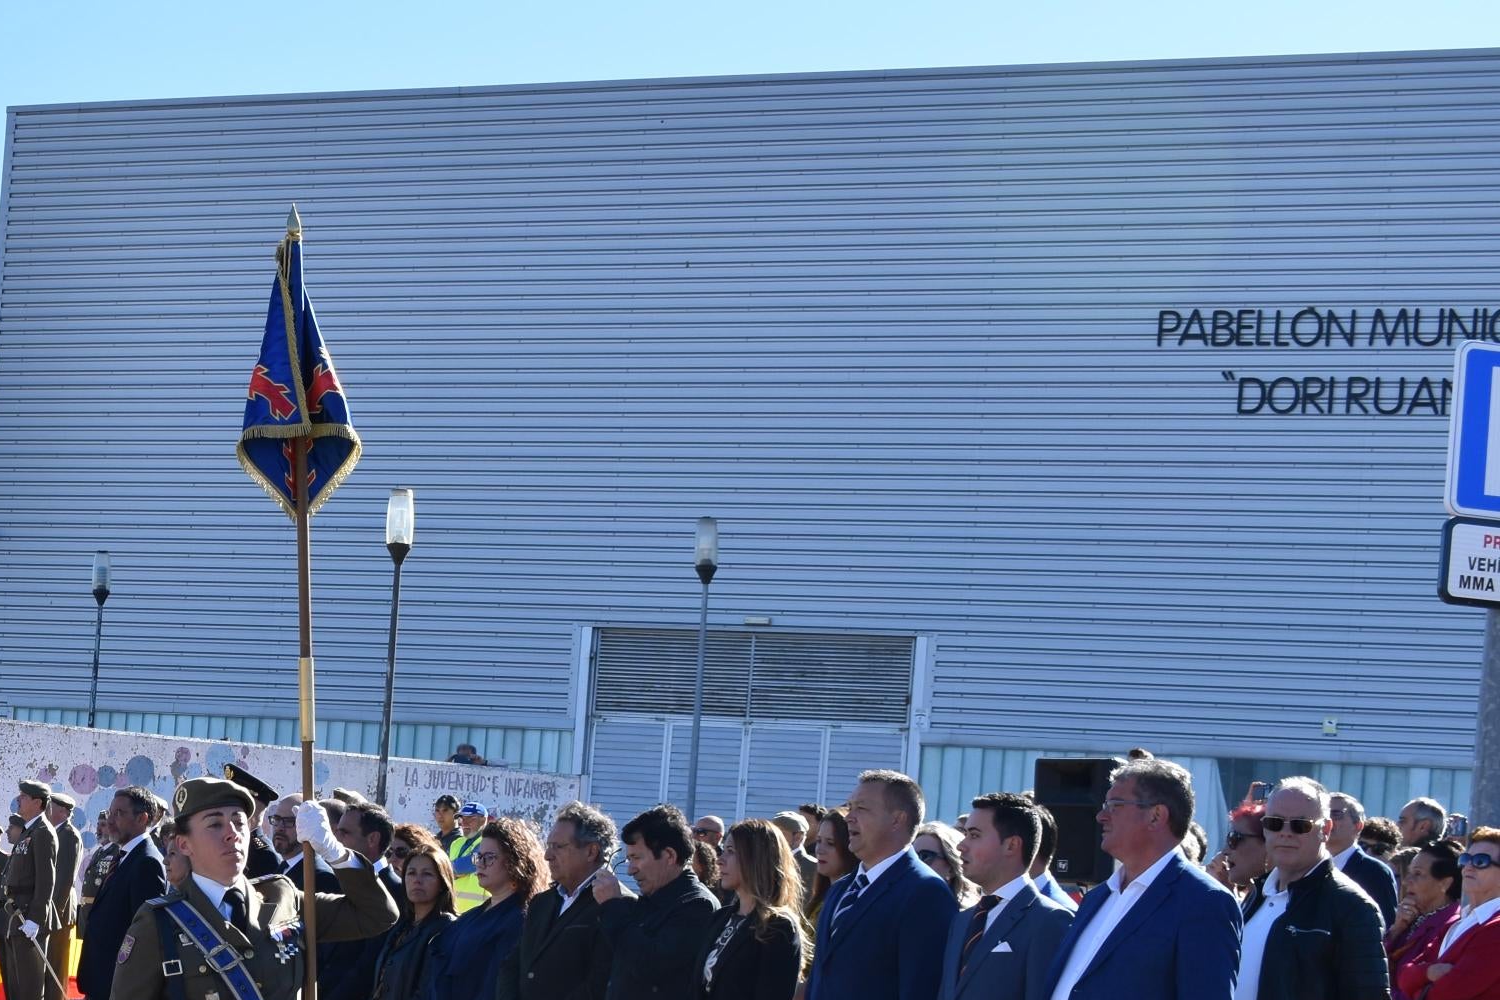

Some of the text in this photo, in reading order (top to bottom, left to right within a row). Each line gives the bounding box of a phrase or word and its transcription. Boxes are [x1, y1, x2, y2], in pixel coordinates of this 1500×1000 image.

[1459, 575, 1494, 592] MMA
[404, 767, 419, 788] LA
[423, 769, 487, 793] JUVENTUD
